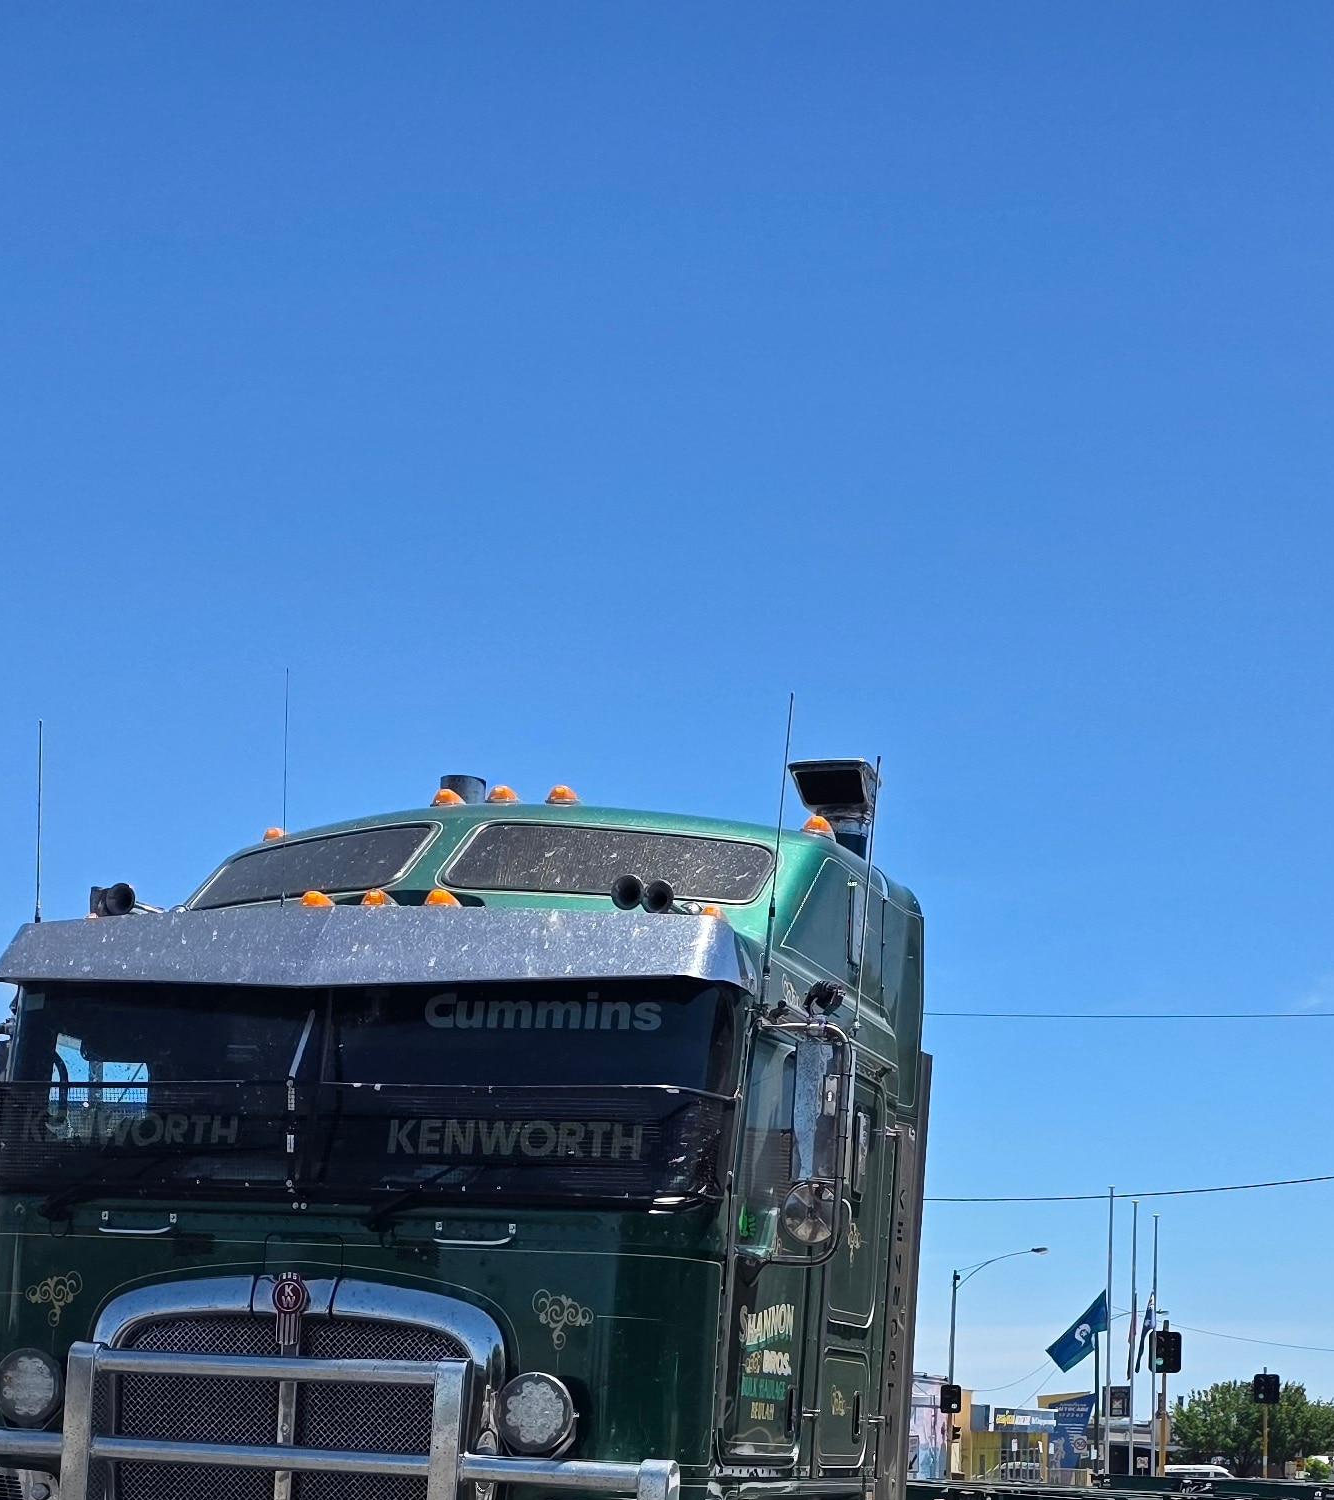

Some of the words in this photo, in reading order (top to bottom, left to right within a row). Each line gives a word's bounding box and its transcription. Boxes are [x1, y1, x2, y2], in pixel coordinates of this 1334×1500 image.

[424, 992, 662, 1031] Cummins
[386, 1119, 643, 1160] KENWORTH
[738, 1304, 795, 1346] SHANNON
